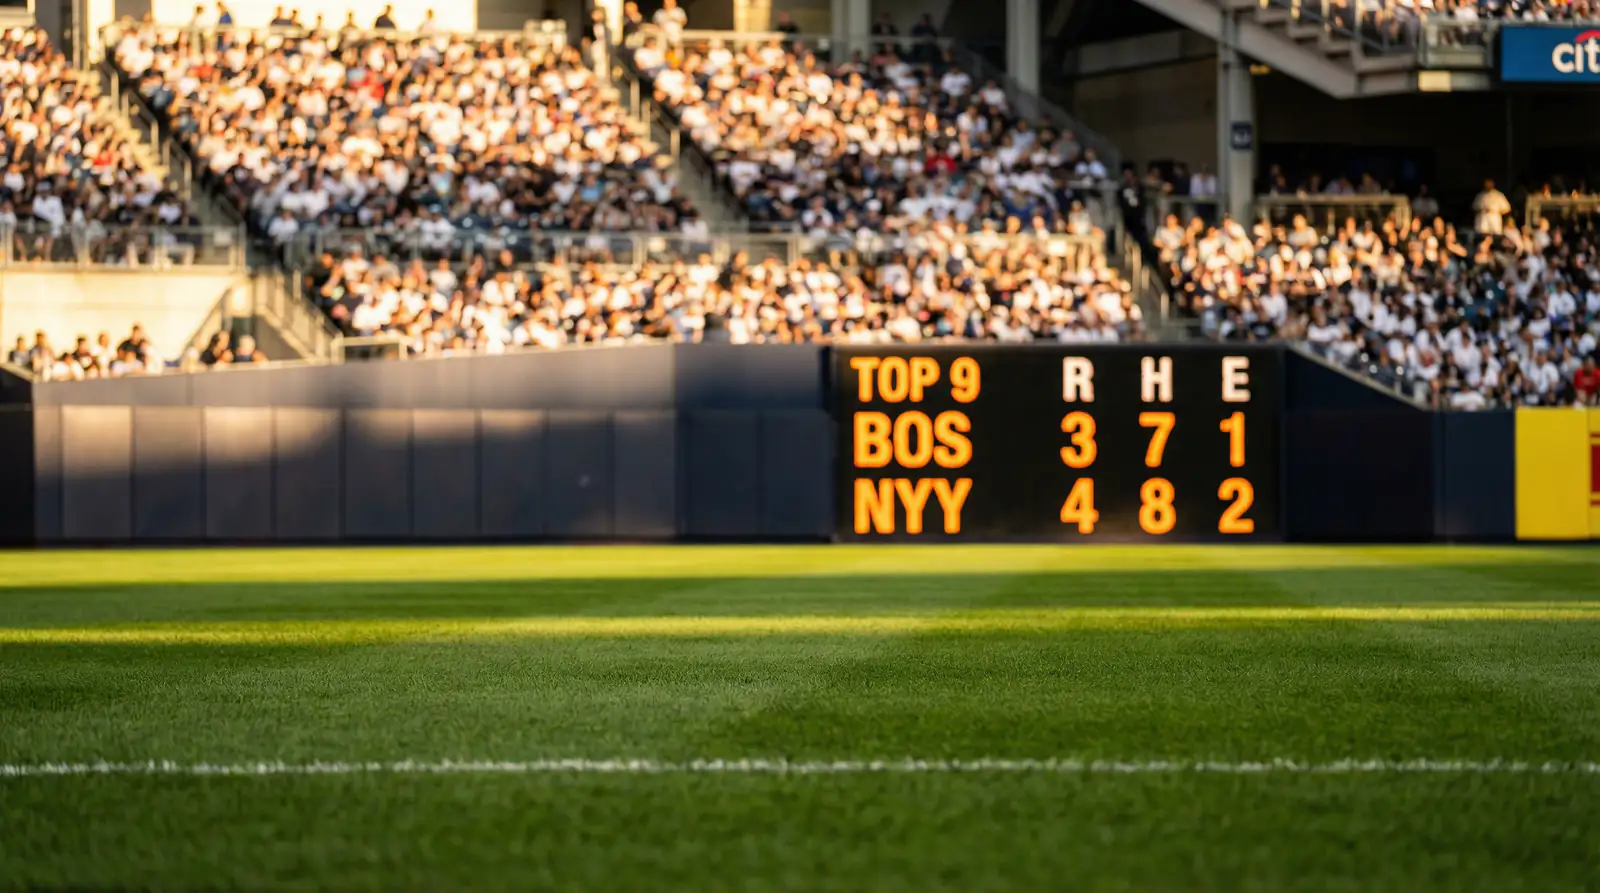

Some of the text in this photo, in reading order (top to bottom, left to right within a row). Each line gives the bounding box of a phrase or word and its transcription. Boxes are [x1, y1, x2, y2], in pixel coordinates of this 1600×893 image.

[849, 356, 1250, 403] TOP 9 R H E
[853, 410, 1245, 468] BOS 3 7 1
[853, 478, 1254, 535] NYY 4 8 2
